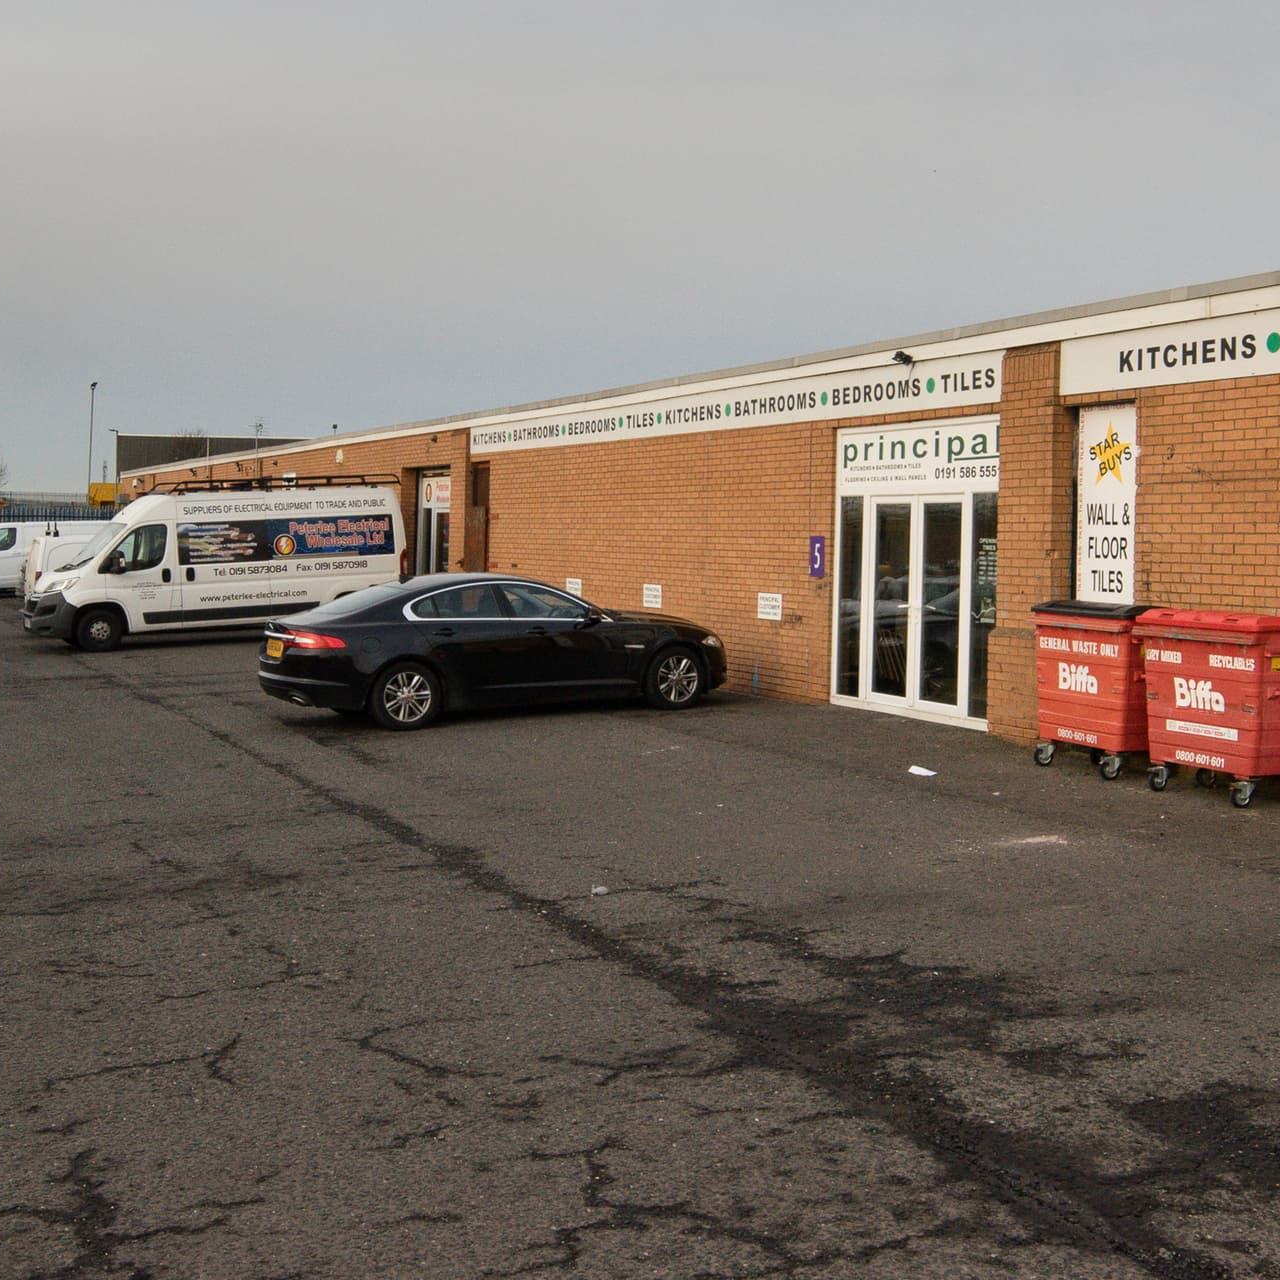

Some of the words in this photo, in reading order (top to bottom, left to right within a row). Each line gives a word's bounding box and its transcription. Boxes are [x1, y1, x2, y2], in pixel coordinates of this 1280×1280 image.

[1119, 334, 1256, 373] KITCHENS
[473, 430, 507, 445] KITCHENS
[513, 425, 560, 441] BATHROOMS
[568, 418, 617, 436] BEDROOMS
[626, 412, 655, 429] TILES
[665, 404, 722, 425] KITCHENS
[734, 391, 817, 417] BATHROOMS
[832, 378, 921, 406] BEDROOMS
[941, 368, 996, 393] TILES
[843, 425, 1000, 469] principal
[1089, 432, 1120, 461] STAR
[934, 467, 956, 480] 0191
[959, 466, 977, 479] 586
[979, 465, 1000, 478] 555
[1099, 446, 1132, 477] BUYS
[183, 505, 222, 516] SUPPLIERS
[224, 505, 234, 514] OF
[234, 503, 273, 514] ELECTRICAL
[274, 501, 312, 511] EQUIPMENT
[316, 501, 324, 510] TO
[325, 500, 347, 509] TRADE
[348, 499, 362, 508] AND
[363, 498, 385, 508] PUBLIC
[1086, 503, 1118, 526] WALL
[1122, 502, 1130, 526] &
[289, 521, 336, 535] Peterlee
[337, 518, 390, 533] Electrical
[306, 533, 364, 548] Wholesale
[366, 531, 385, 545] Ltd
[1088, 536, 1128, 560] FLOOR
[229, 567, 246, 576] 0191
[248, 564, 288, 575] 5873084
[314, 562, 331, 571] 0191
[332, 560, 368, 570] 5870918
[814, 543, 821, 569] 5
[1091, 569, 1123, 594] TILES
[200, 589, 308, 602] www.peterlee-electrical.com
[1040, 636, 1070, 651] GENERAL
[1072, 639, 1098, 655] WASTE
[1100, 643, 1119, 657] ONLY
[1161, 650, 1182, 664] MIXED
[1209, 654, 1255, 672] RECYCLABLES
[1058, 662, 1098, 695] Biffa
[1173, 676, 1225, 712] Biffa
[1057, 727, 1098, 744] 0800-601-601
[1175, 750, 1225, 768] 0800-601-601
